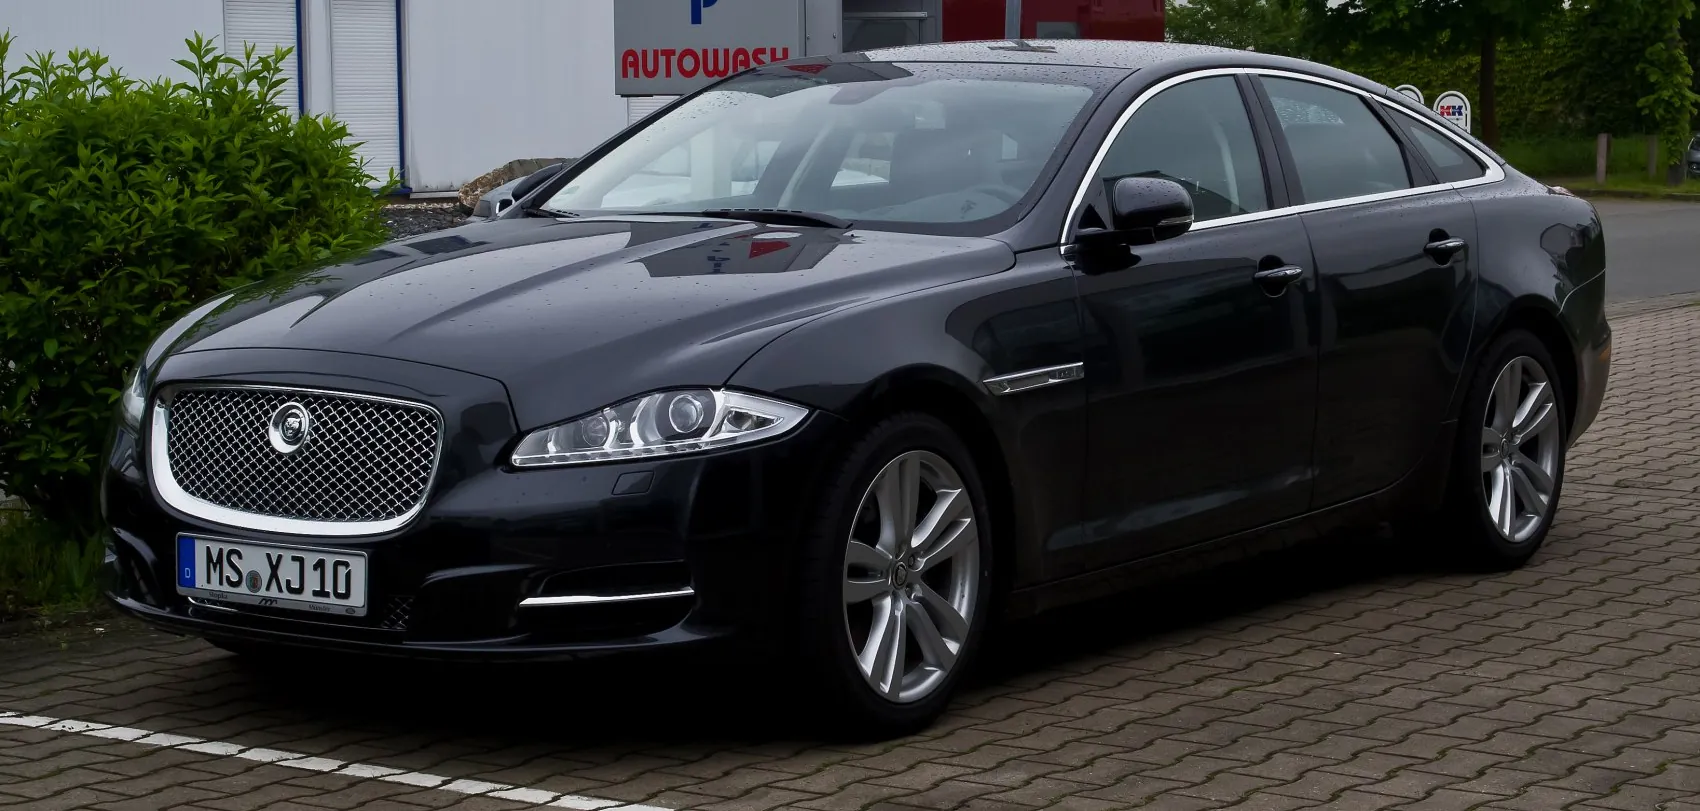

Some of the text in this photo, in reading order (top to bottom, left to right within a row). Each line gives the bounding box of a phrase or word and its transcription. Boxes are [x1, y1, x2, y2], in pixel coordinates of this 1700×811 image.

[1440, 105, 1463, 117] KK
[184, 568, 191, 578] D
[206, 545, 243, 588] MS
